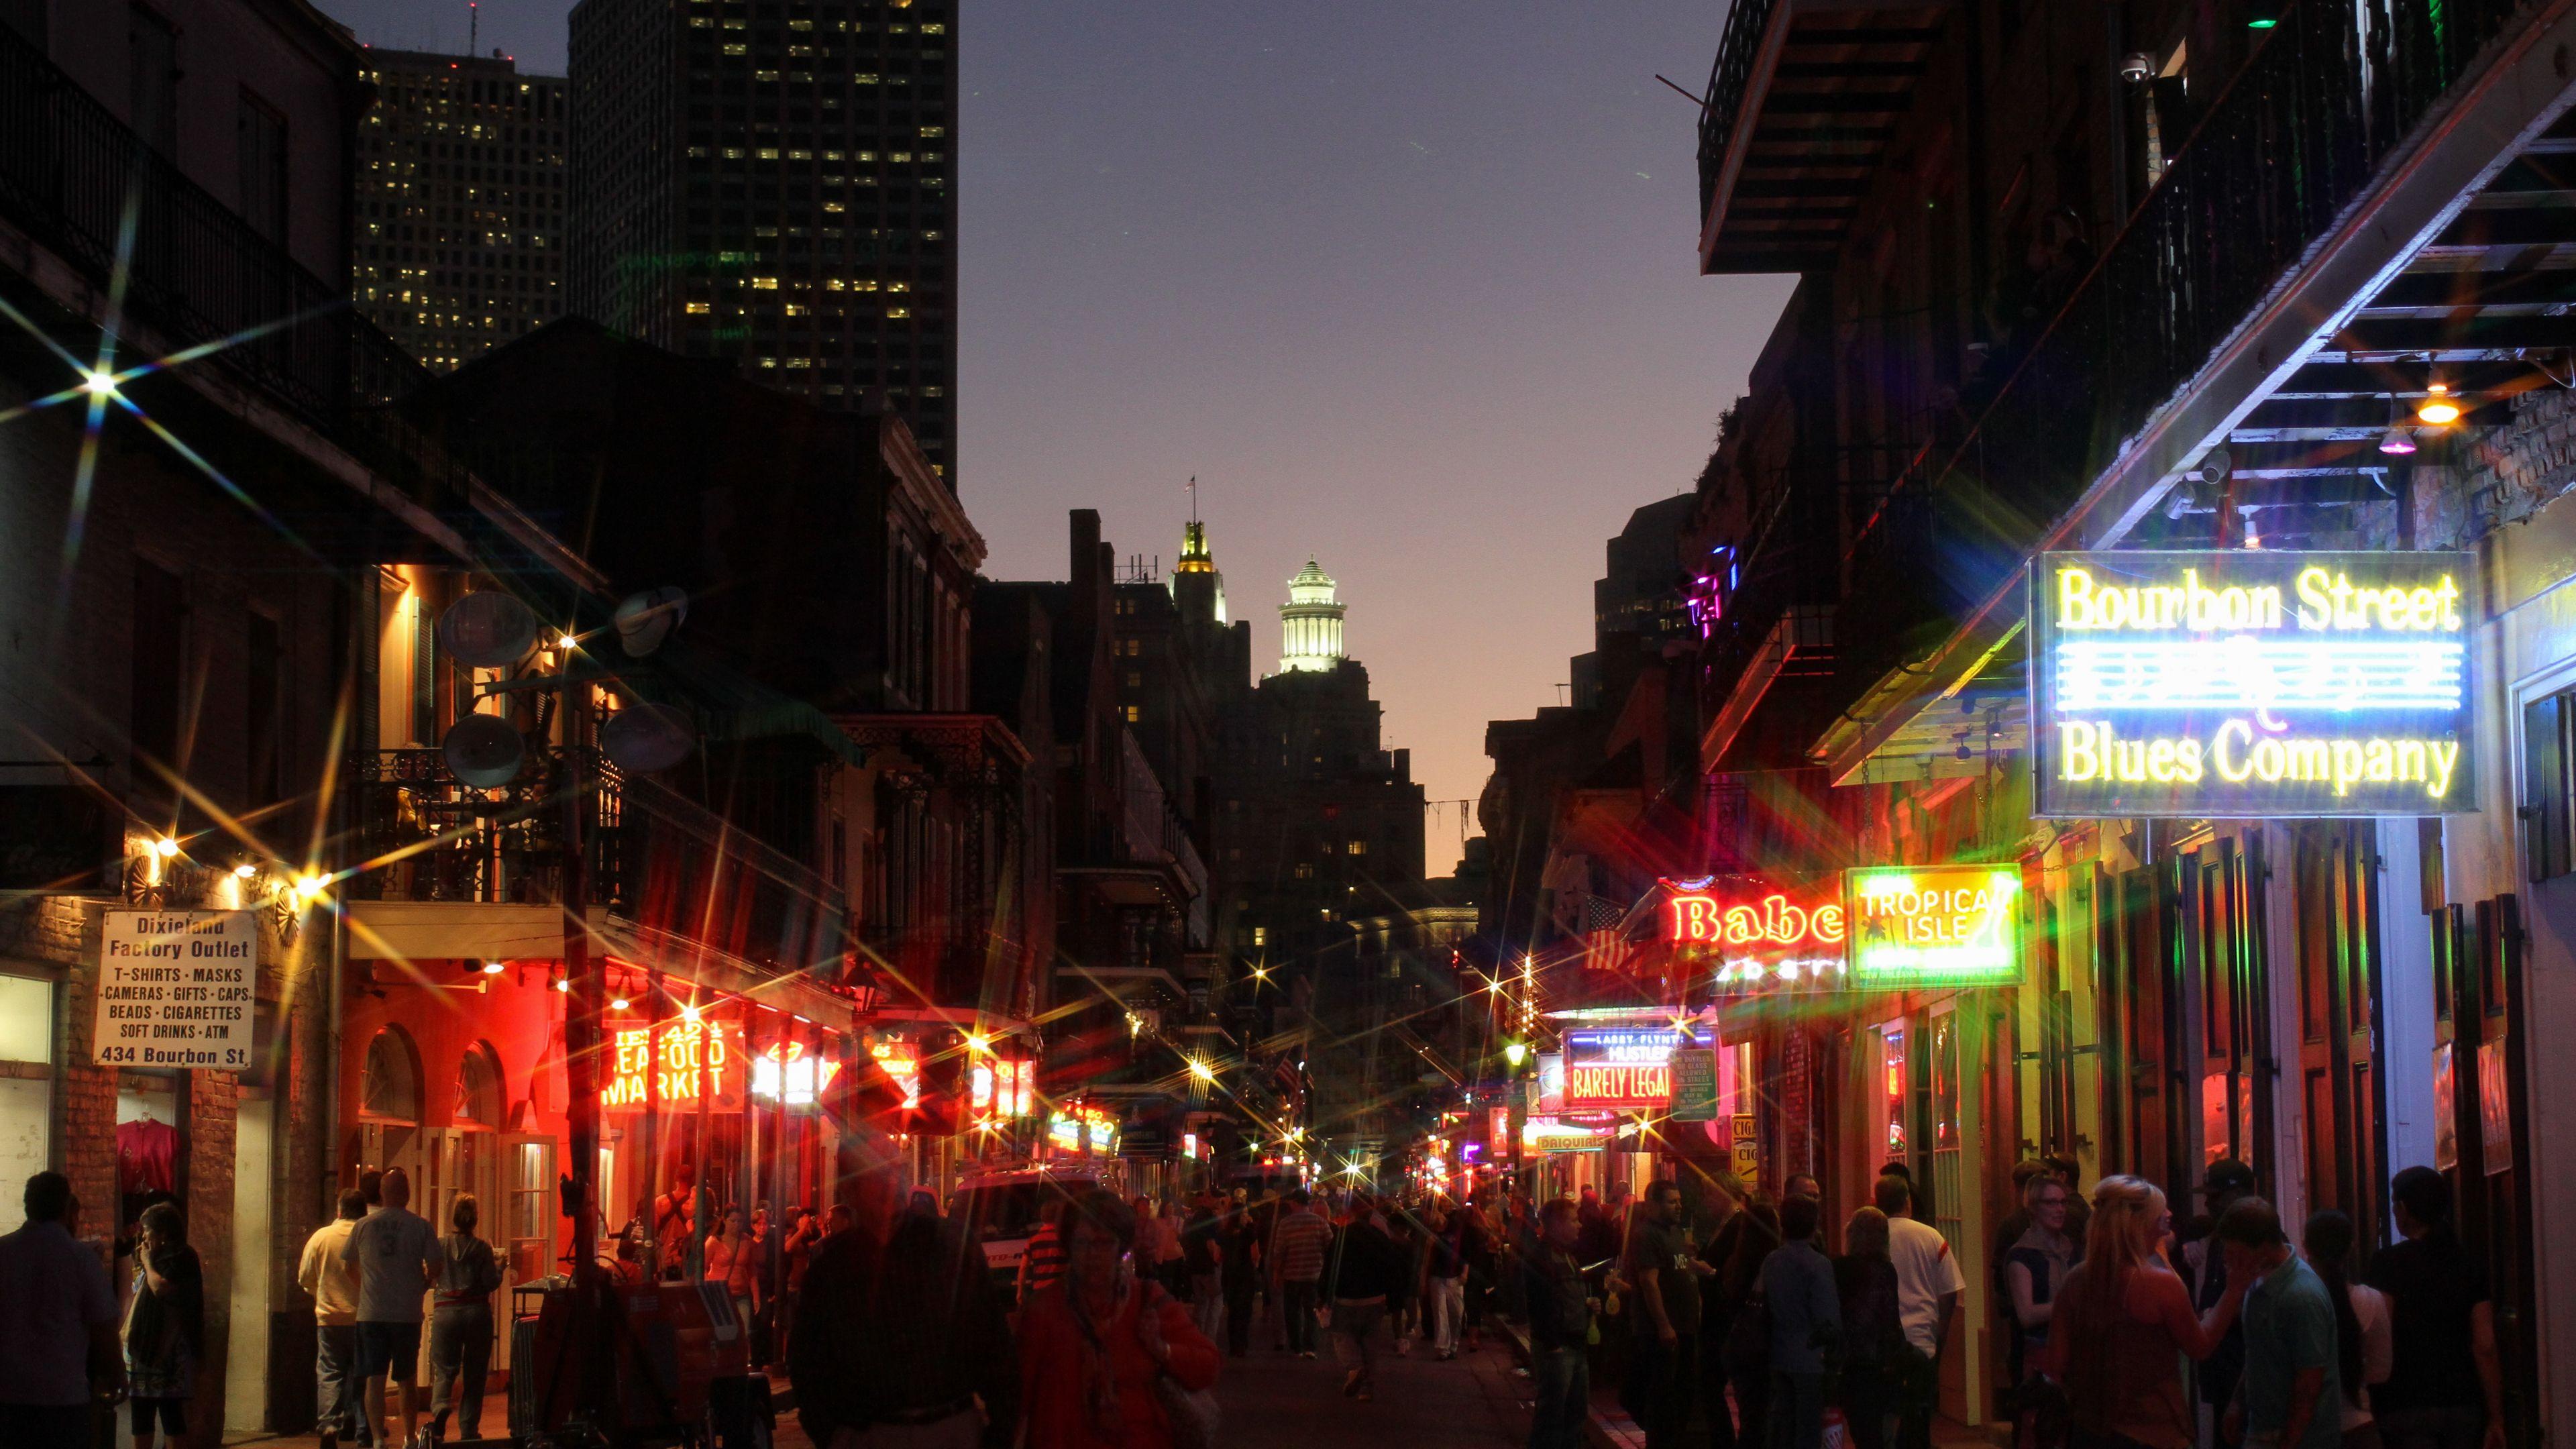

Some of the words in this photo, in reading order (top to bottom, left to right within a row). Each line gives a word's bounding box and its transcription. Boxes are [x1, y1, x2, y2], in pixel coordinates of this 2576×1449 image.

[2055, 568, 2282, 629] Bourbon
[2296, 566, 2462, 631] Street
[2057, 720, 2203, 782] Blues
[2214, 719, 2460, 798] Company
[137, 918, 224, 934] Dixieland
[1907, 915, 1970, 941] ISLE
[110, 940, 182, 959] Factory
[191, 941, 248, 958] Outlet
[114, 967, 180, 982] T-SHIRTS
[193, 968, 242, 983] MASKS
[105, 986, 163, 1000] CAMERAS
[174, 987, 207, 1001] GIFTS
[217, 987, 248, 1001] CAPS
[109, 1006, 152, 1019] BEADS
[163, 1006, 241, 1020] CIGARETTES
[121, 1024, 149, 1038] SOFT
[154, 1025, 195, 1038] DRINKS
[205, 1026, 229, 1038] ATM
[1596, 1035, 1633, 1044] LARRY
[101, 1046, 136, 1062] 434
[144, 1047, 217, 1063] Bourbon
[1609, 1046, 1669, 1061] HUSTLER
[1573, 1067, 1626, 1097] BARELY
